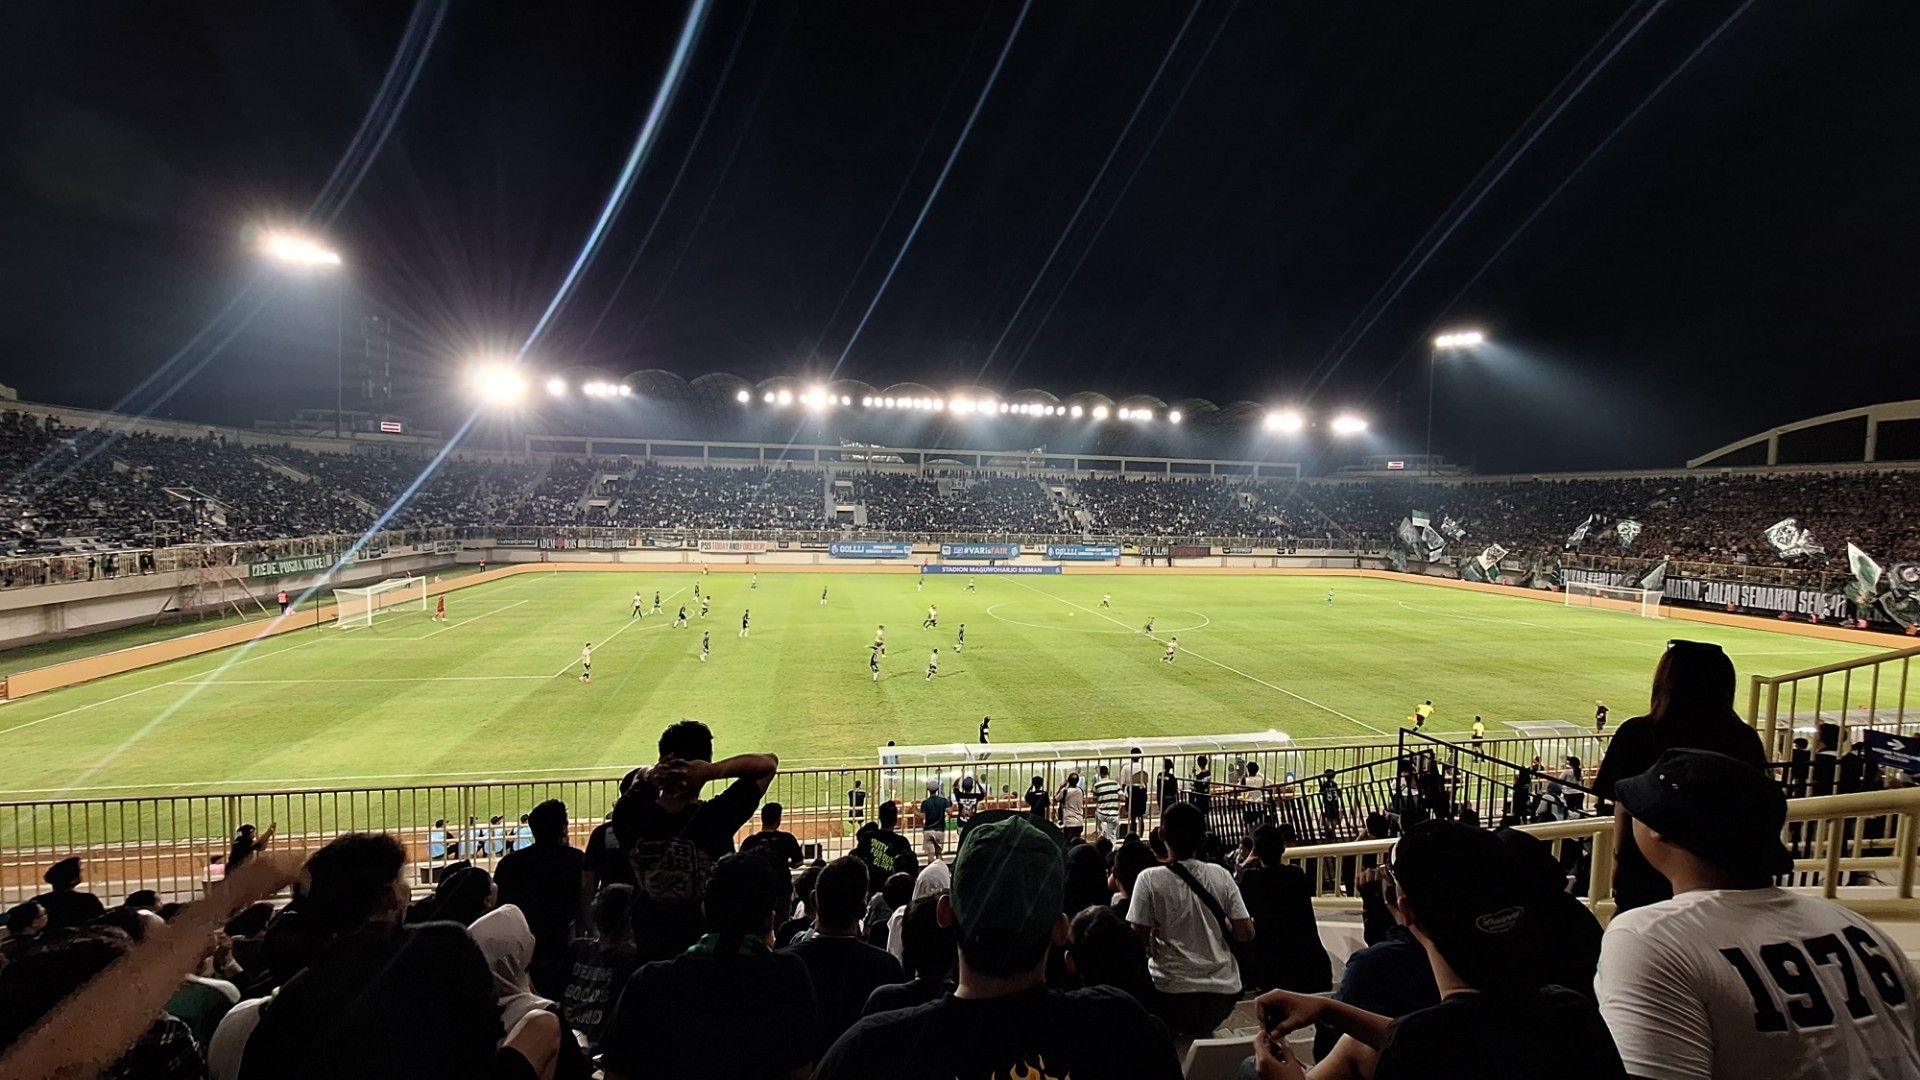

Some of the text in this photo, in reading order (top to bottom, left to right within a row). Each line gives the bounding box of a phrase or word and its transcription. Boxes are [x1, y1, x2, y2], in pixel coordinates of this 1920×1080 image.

[1705, 582, 1740, 605] JALAN
[1741, 585, 1797, 612] SEMAKIN
[1718, 925, 1906, 1032] 1976
